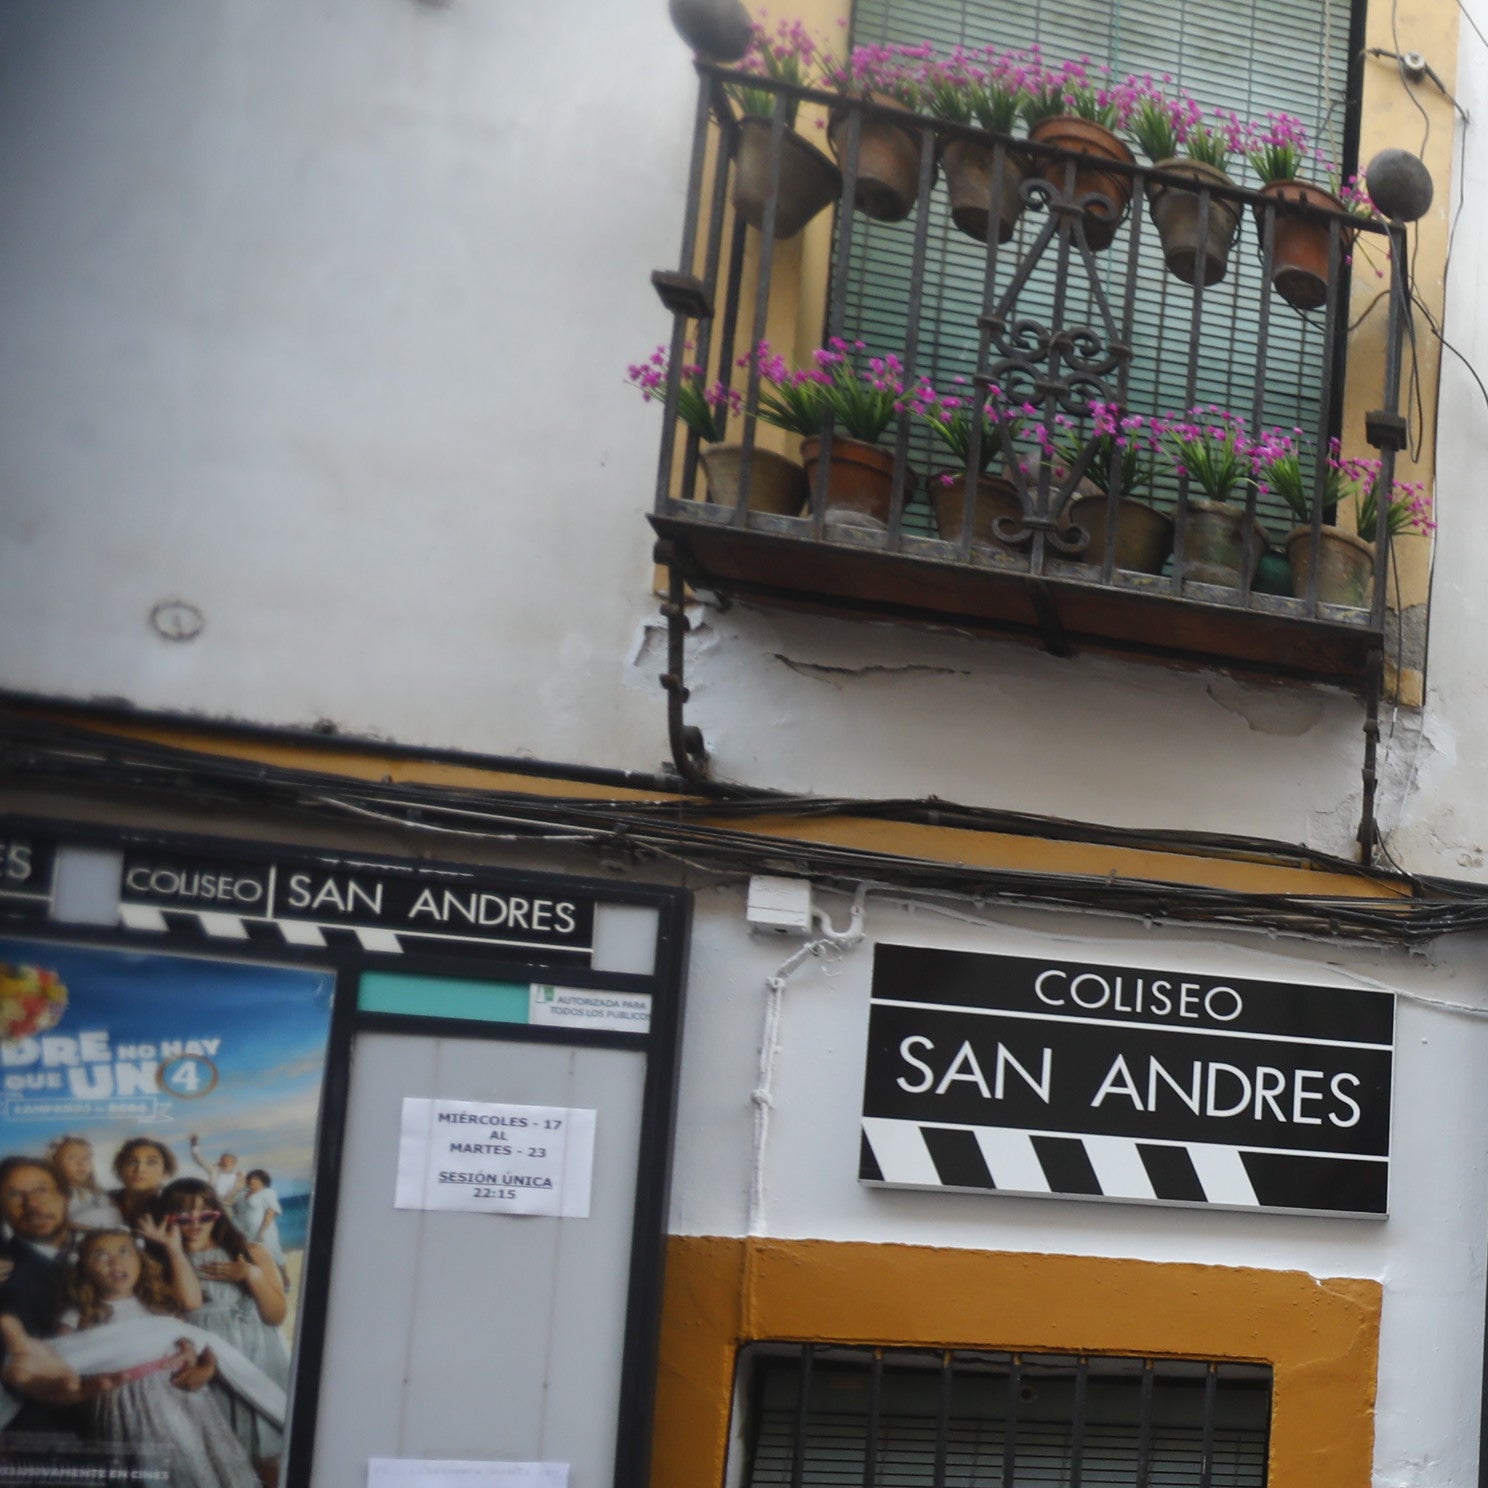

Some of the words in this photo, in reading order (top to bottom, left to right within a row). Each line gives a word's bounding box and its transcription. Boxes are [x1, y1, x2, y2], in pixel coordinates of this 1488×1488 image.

[0, 843, 33, 880] S
[127, 868, 263, 901] COLISEO
[288, 874, 383, 915] SAN
[408, 888, 577, 934] ANDRES
[1034, 969, 1243, 1022] COLISEO
[550, 1006, 584, 1017] TODOS
[586, 1009, 604, 1018] LOS
[118, 1044, 156, 1060] NO
[161, 1037, 221, 1058] HAY
[4, 1073, 62, 1090] QUE
[171, 1060, 200, 1091] 4
[896, 1035, 1052, 1104] SAN
[1091, 1053, 1361, 1129] ANDRES
[438, 1111, 528, 1128] MIÉRCOLES
[544, 1120, 562, 1130] 17
[489, 1131, 509, 1141] AL
[450, 1143, 512, 1156] MARTES
[528, 1147, 547, 1158] 23
[439, 1170, 497, 1184] SESIÓN
[502, 1172, 552, 1188] ÚNICA
[473, 1187, 516, 1200] 22:15
